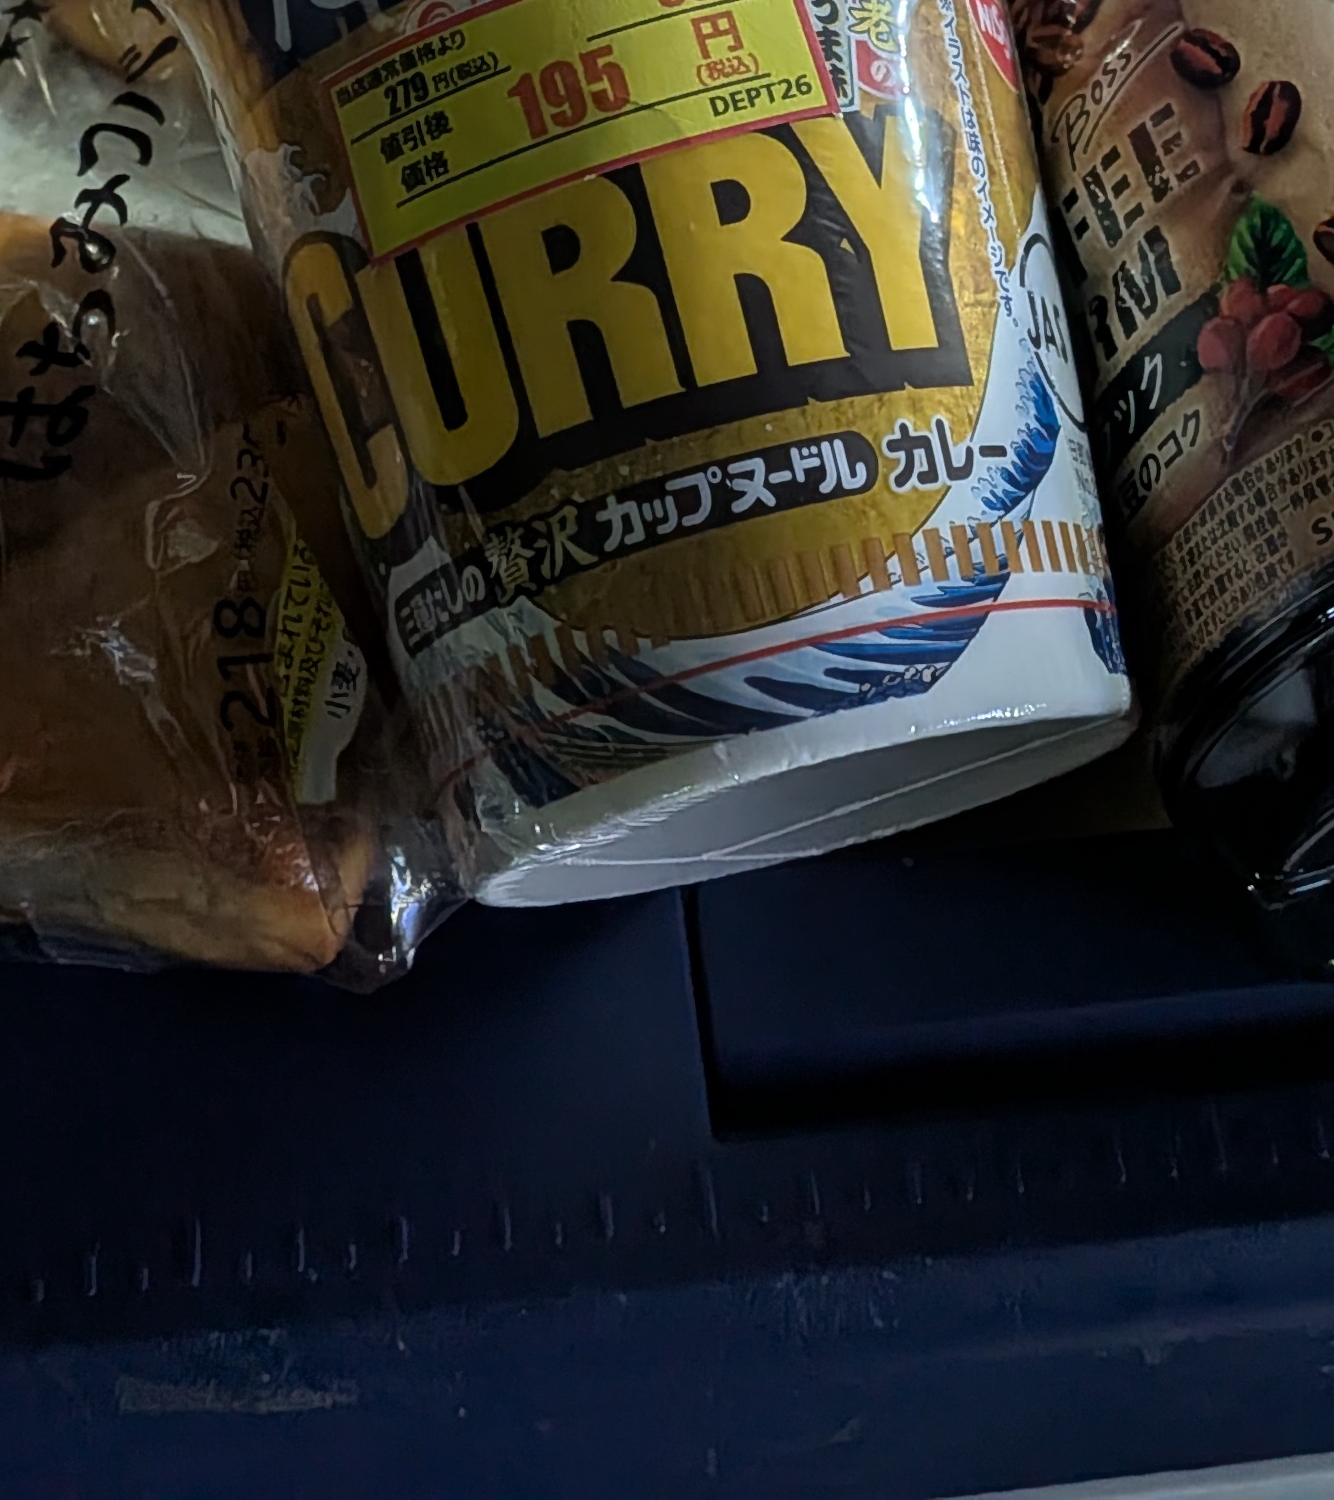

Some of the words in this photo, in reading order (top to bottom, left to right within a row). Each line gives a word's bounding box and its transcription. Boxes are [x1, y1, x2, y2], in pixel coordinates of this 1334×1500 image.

[384, 79, 430, 124] 279
[507, 45, 632, 141] 195
[691, 8, 738, 51] 円
[708, 74, 816, 121] DEPT26
[379, 107, 456, 164] 値引後
[399, 149, 452, 195] 価格
[284, 108, 952, 542] CURRY
[602, 435, 871, 553] カップヌードル
[889, 416, 1010, 492] カレー
